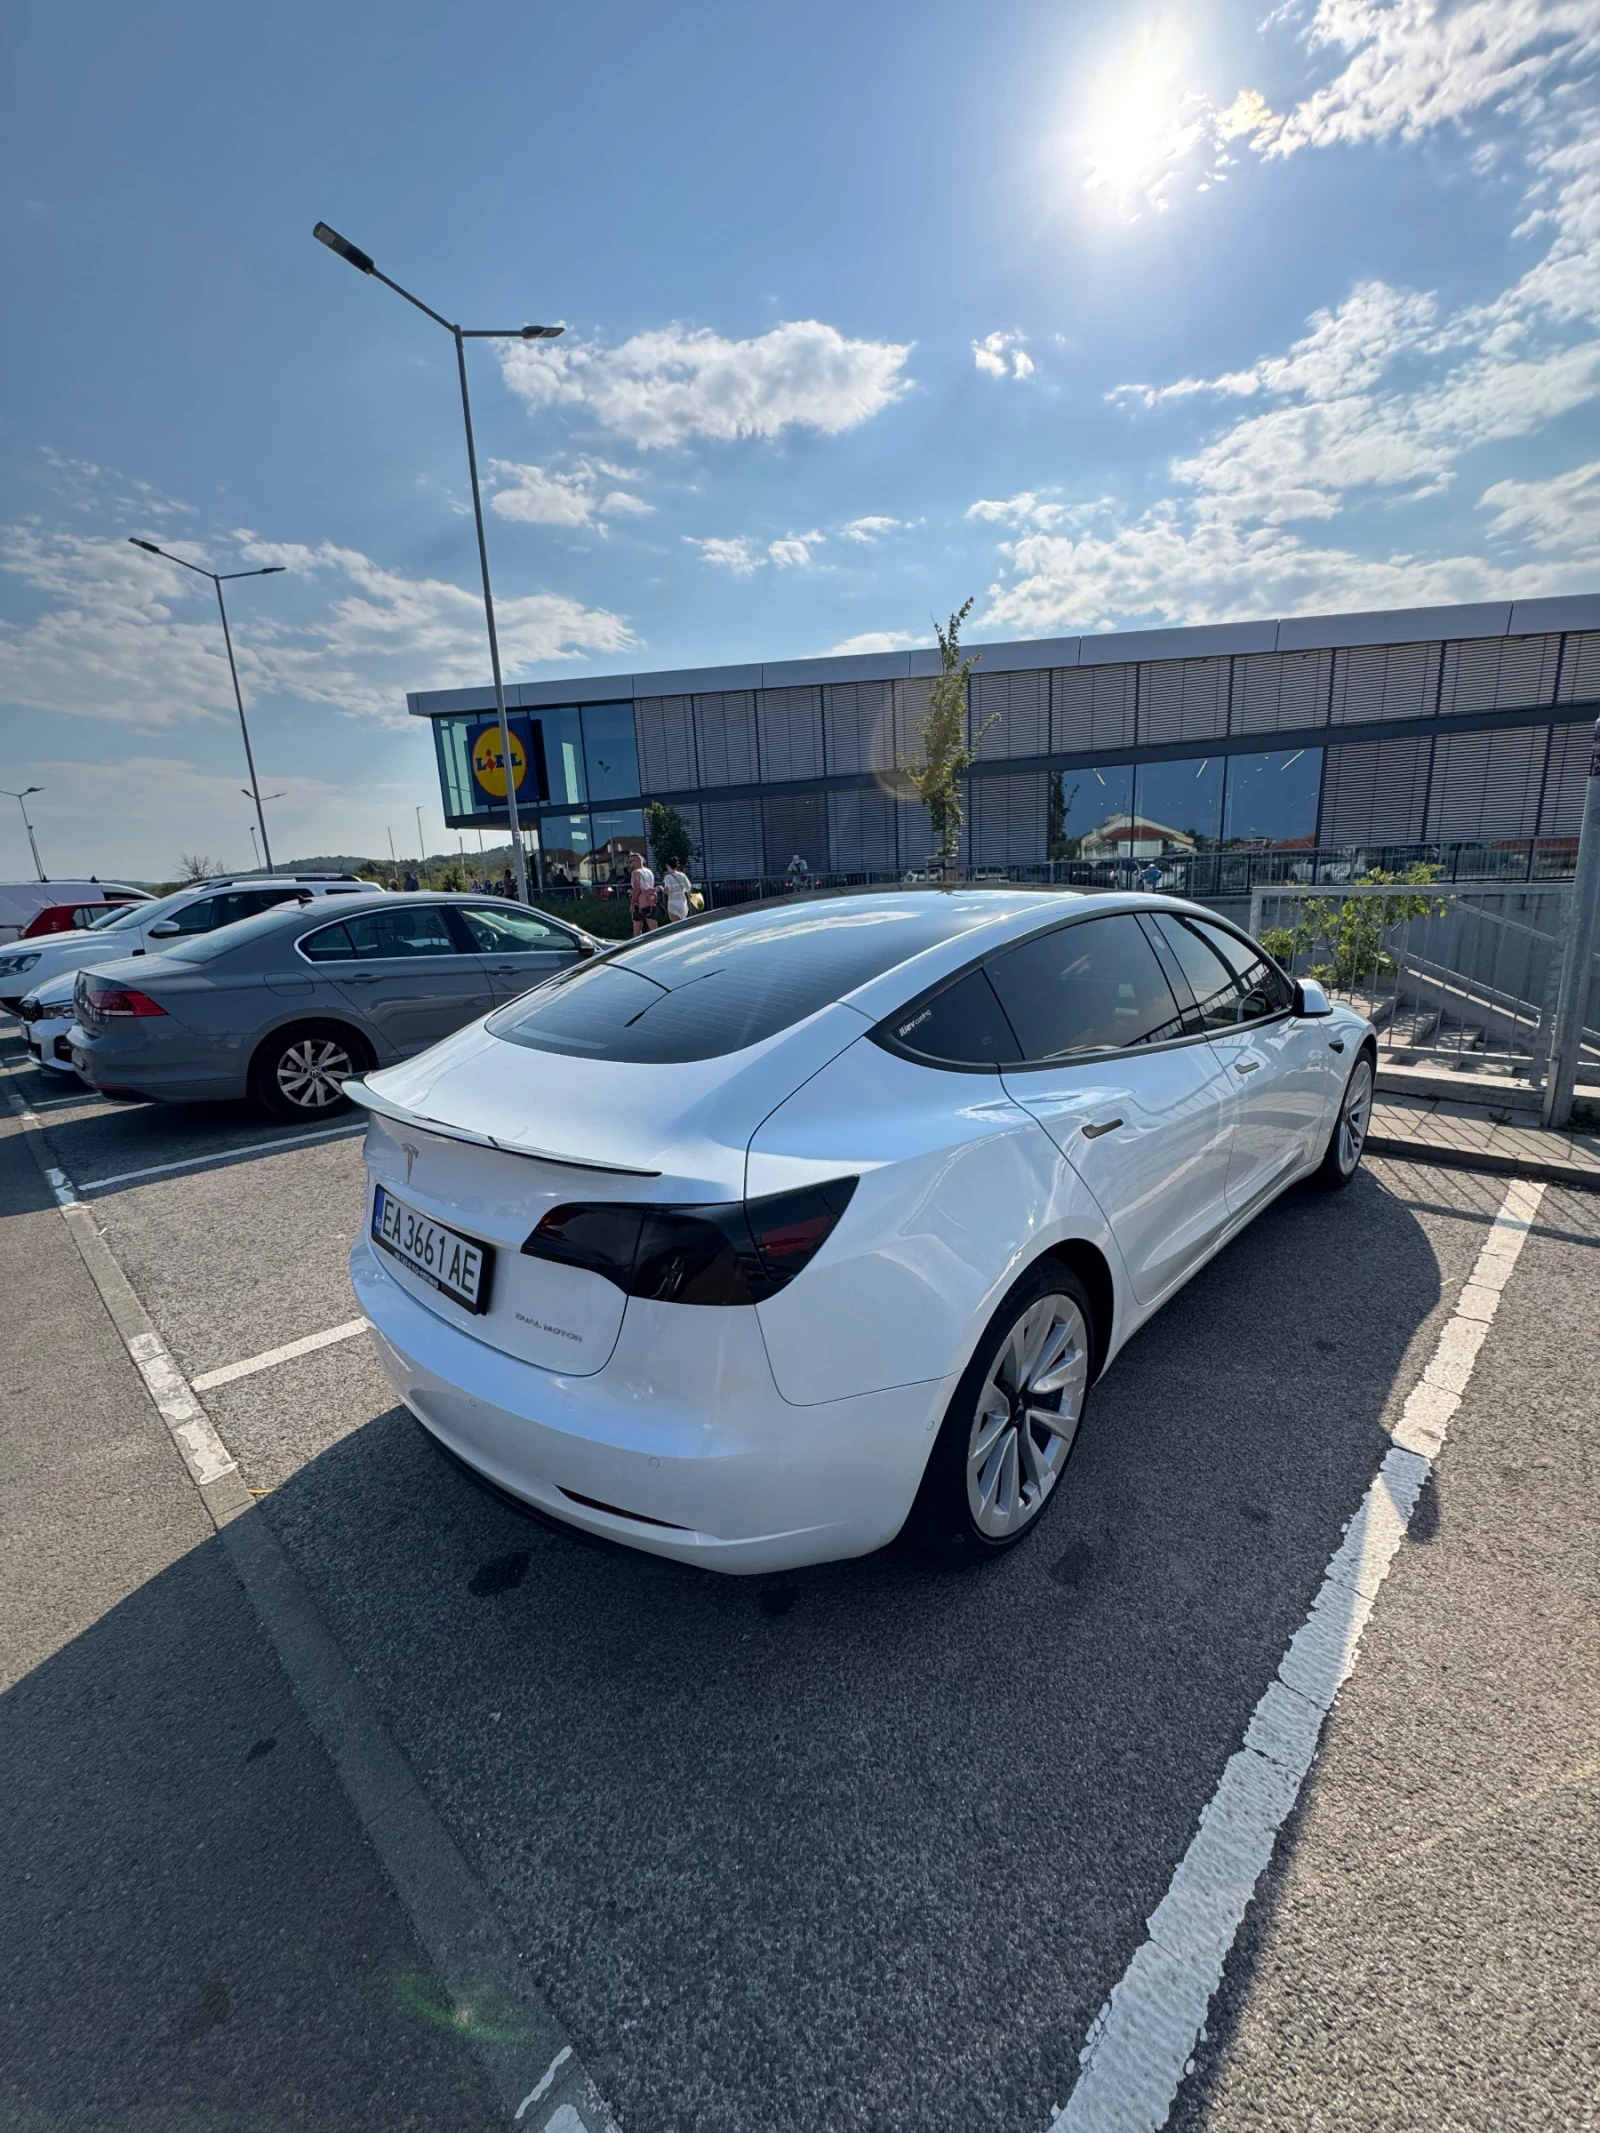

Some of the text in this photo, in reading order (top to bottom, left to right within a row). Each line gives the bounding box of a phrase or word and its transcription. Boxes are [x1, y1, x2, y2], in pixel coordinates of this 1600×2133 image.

[382, 1199, 401, 1246] EA
[404, 1214, 446, 1273] 3661
[448, 1243, 478, 1296] AE
[515, 1311, 583, 1343] DUAL MOTOR
